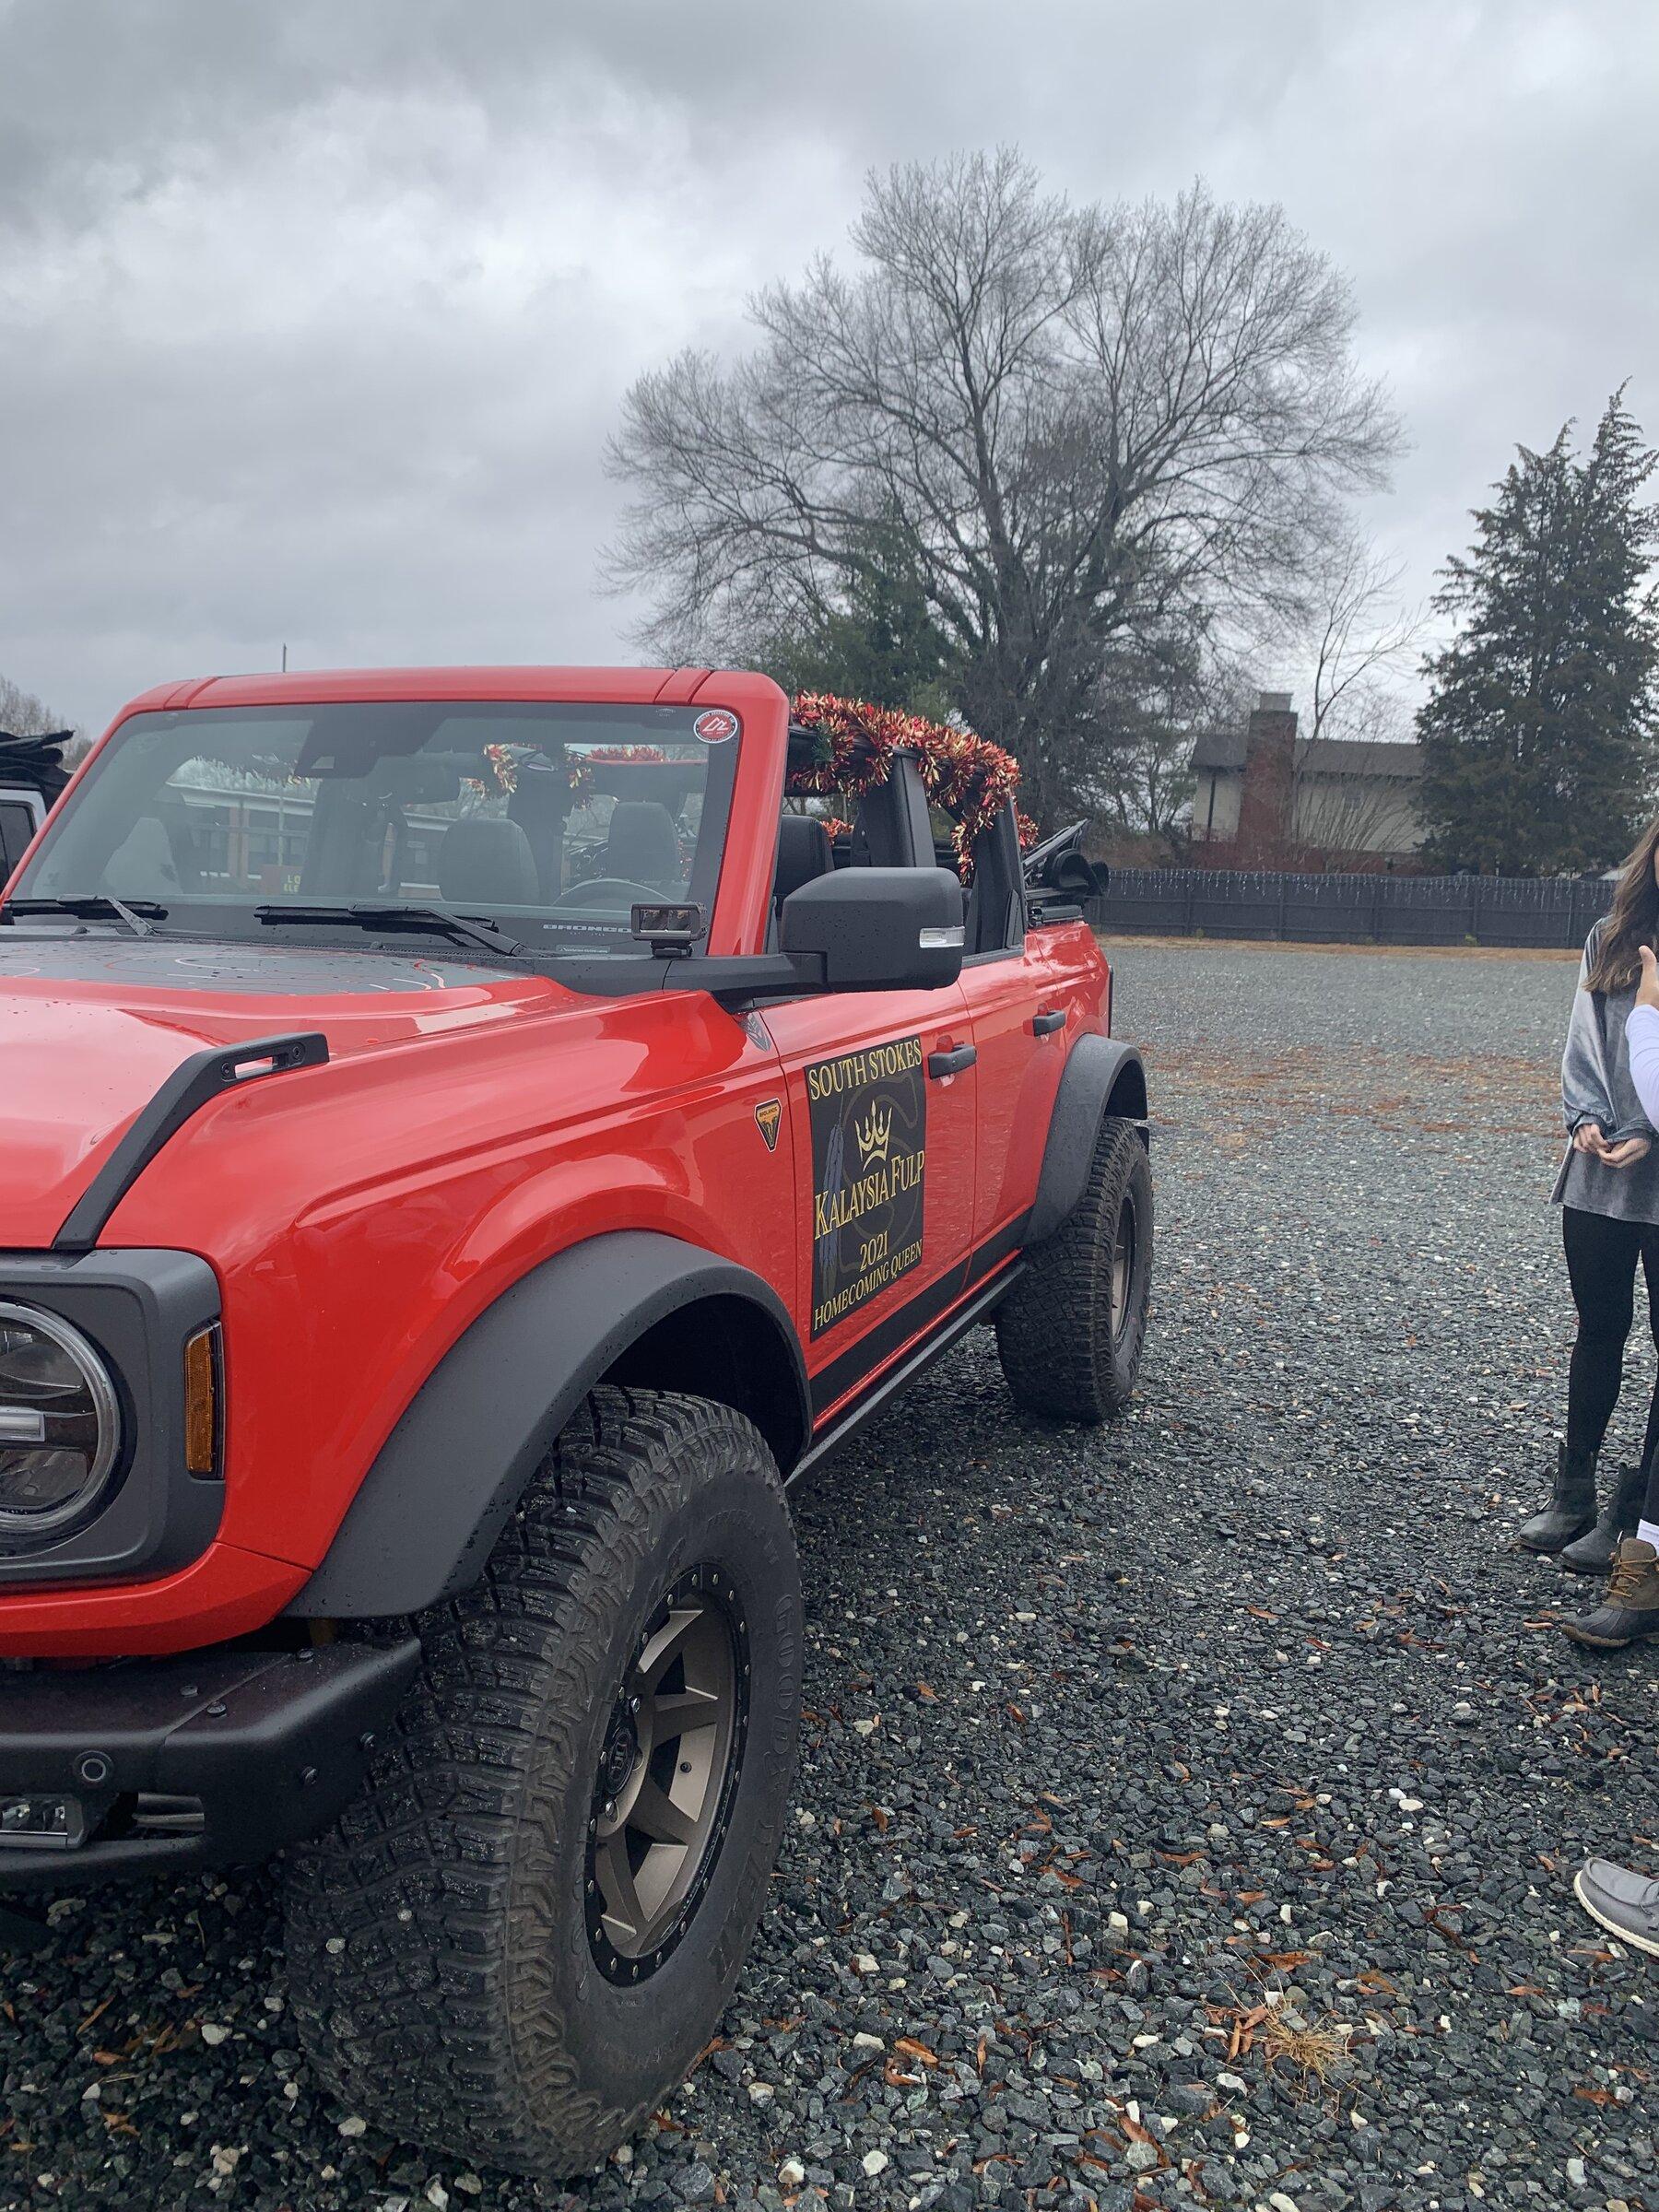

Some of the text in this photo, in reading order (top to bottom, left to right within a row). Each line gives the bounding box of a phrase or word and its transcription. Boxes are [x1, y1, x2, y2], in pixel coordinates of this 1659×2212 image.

[808, 1039, 922, 1100] SOUTH STOKES
[814, 1150, 925, 1241] KALAYSIA FULP
[814, 1239, 923, 1331] HOMECOMING QUEEN
[859, 1230, 888, 1273] 2021
